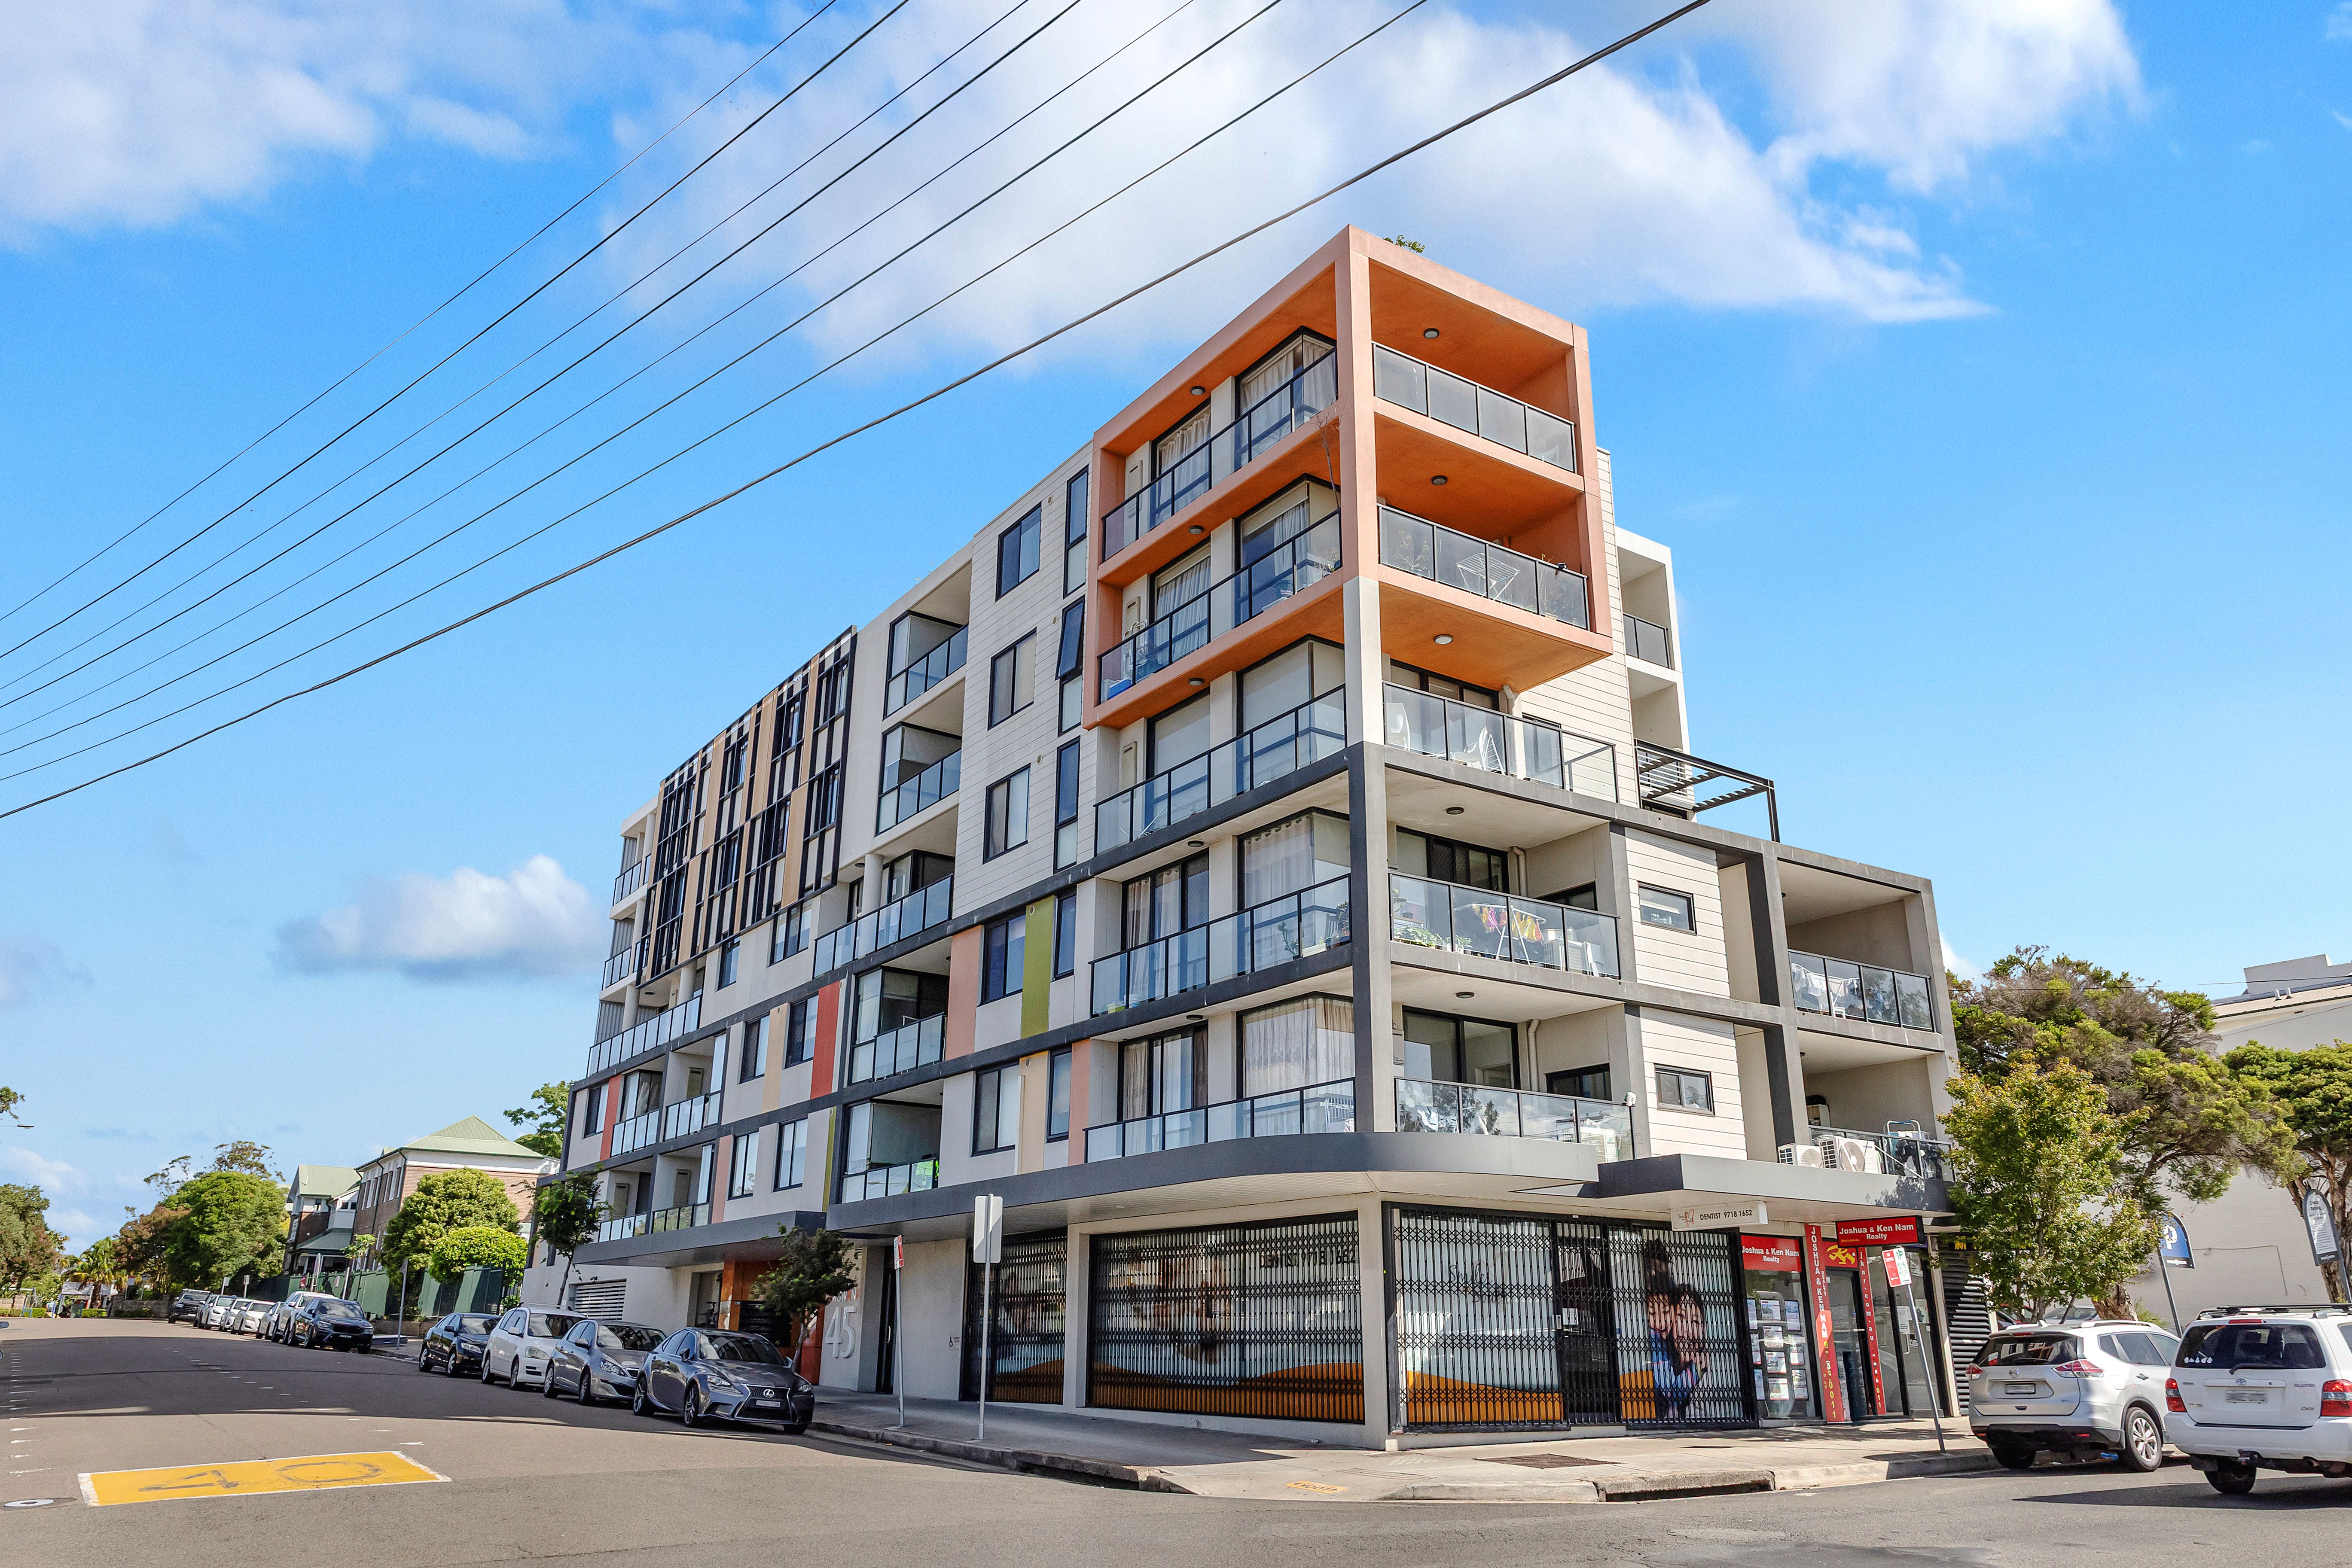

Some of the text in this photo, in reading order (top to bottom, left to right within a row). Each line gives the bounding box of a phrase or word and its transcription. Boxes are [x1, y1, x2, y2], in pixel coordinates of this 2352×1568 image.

[2163, 1225, 2177, 1249] P
[1742, 1246, 1764, 1254] Joshua
[1763, 1255, 1779, 1264] Realty
[1811, 1227, 1820, 1275] JOSHUA
[825, 1306, 857, 1358] 45
